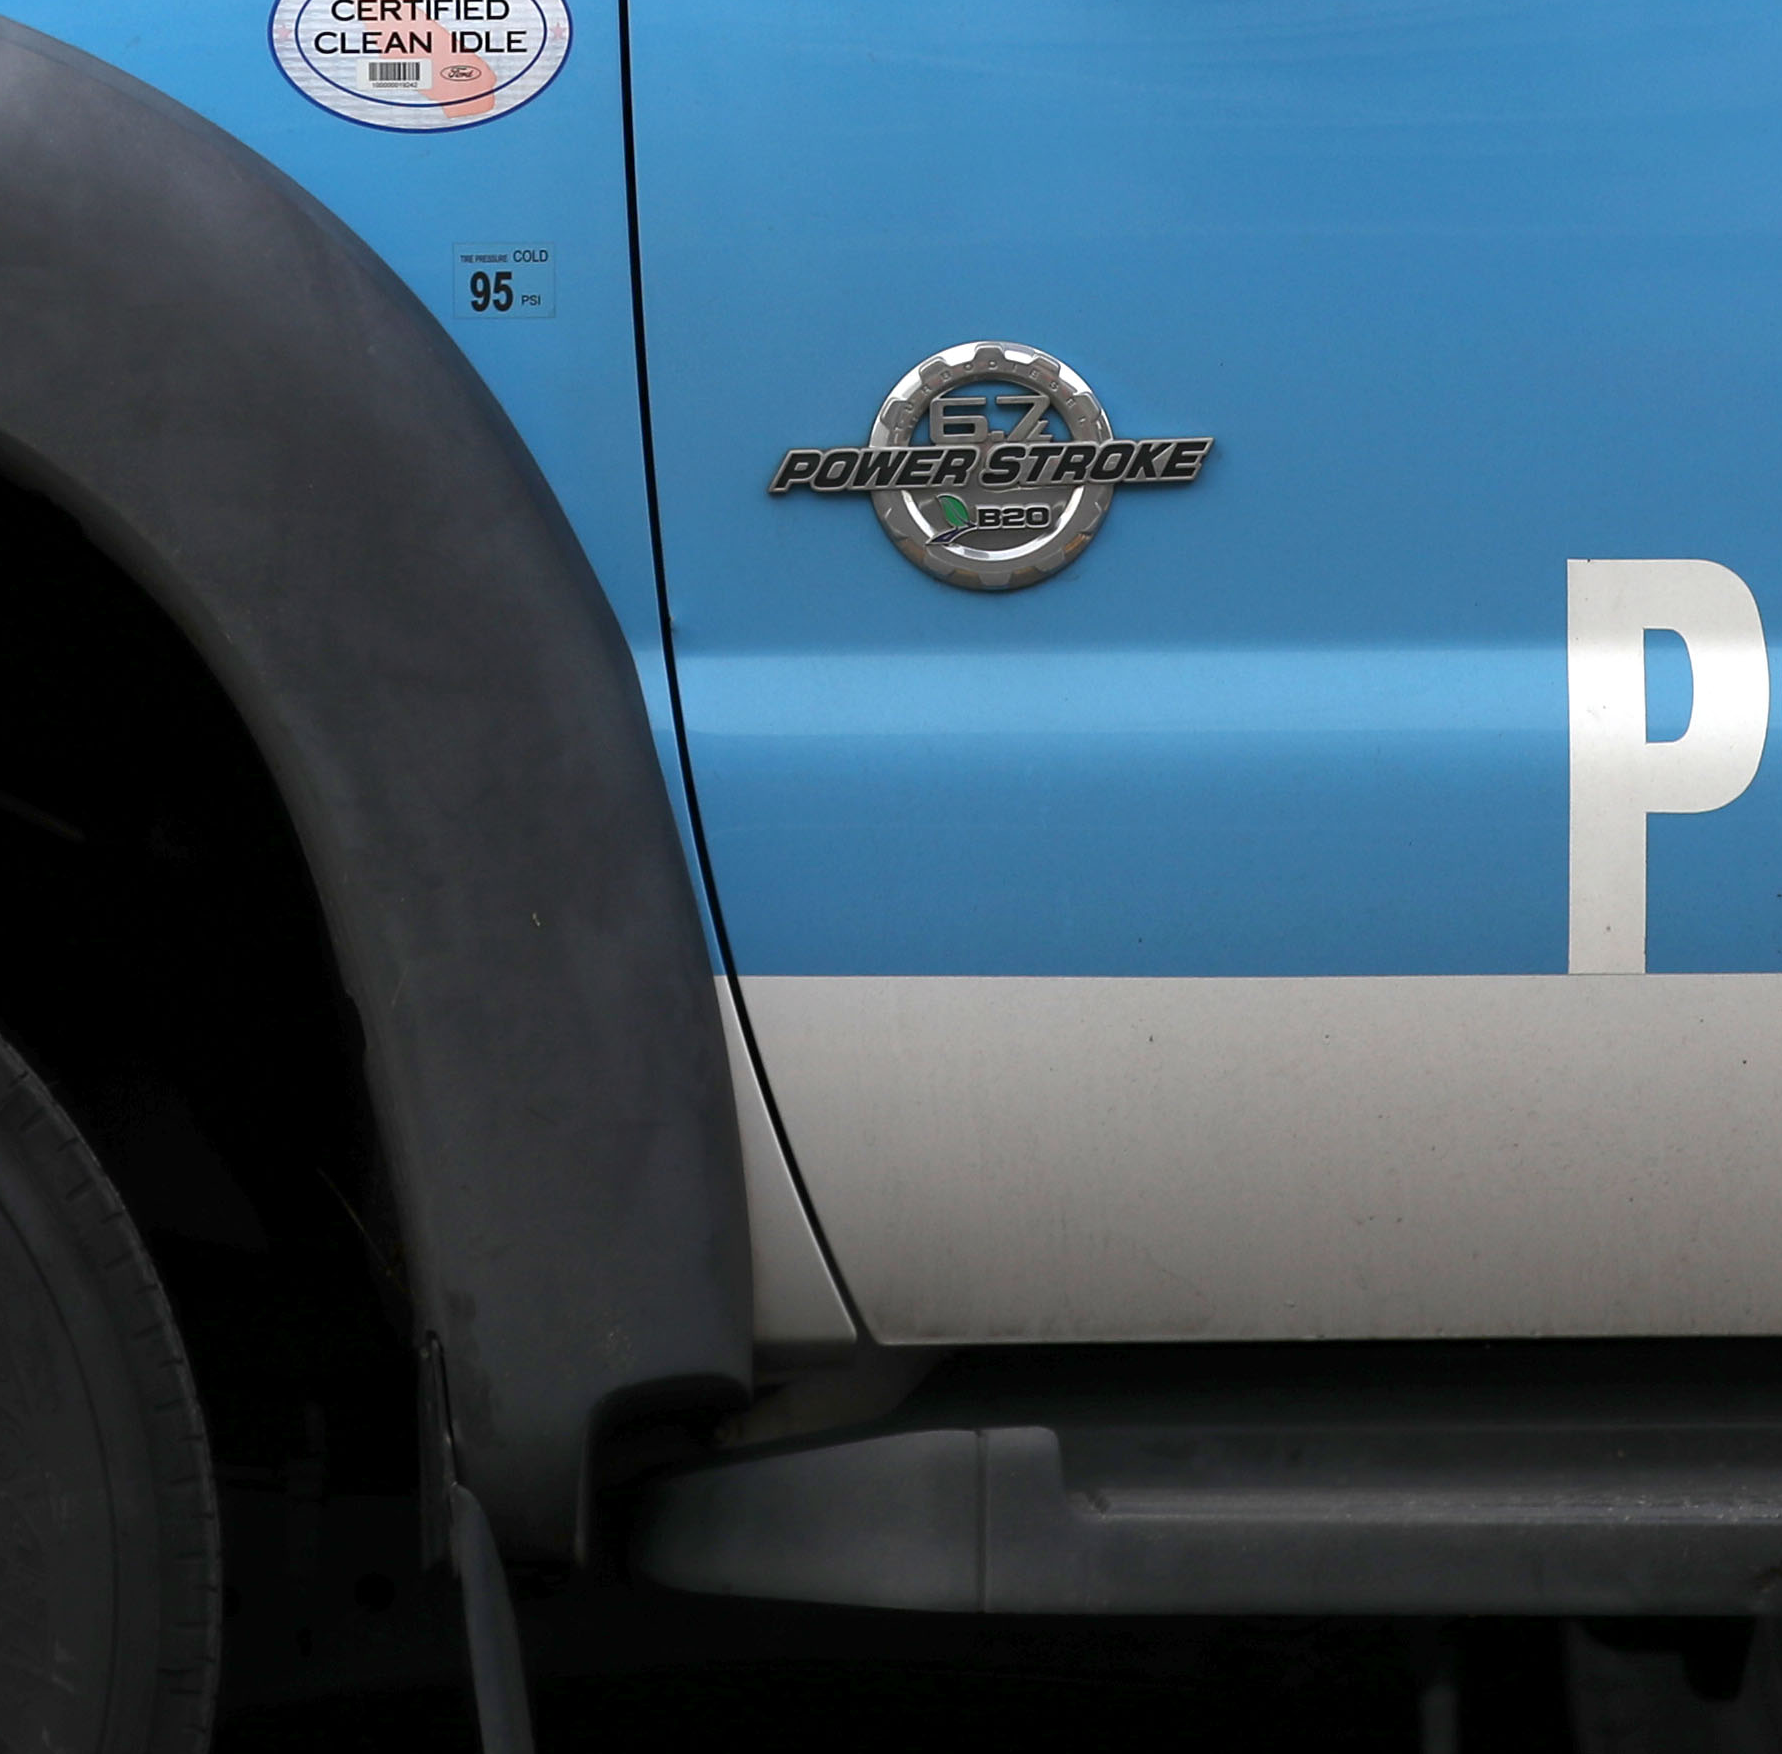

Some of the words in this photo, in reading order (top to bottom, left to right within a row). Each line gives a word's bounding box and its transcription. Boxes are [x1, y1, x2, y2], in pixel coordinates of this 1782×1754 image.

[314, 31, 432, 55] CLEAN
[451, 31, 528, 54] IDLE
[513, 249, 549, 263] COLD
[470, 271, 513, 313] 95
[521, 295, 542, 306] PSI
[769, 446, 978, 493] POWER
[979, 438, 1214, 490] STROKE
[976, 504, 1052, 530] B20
